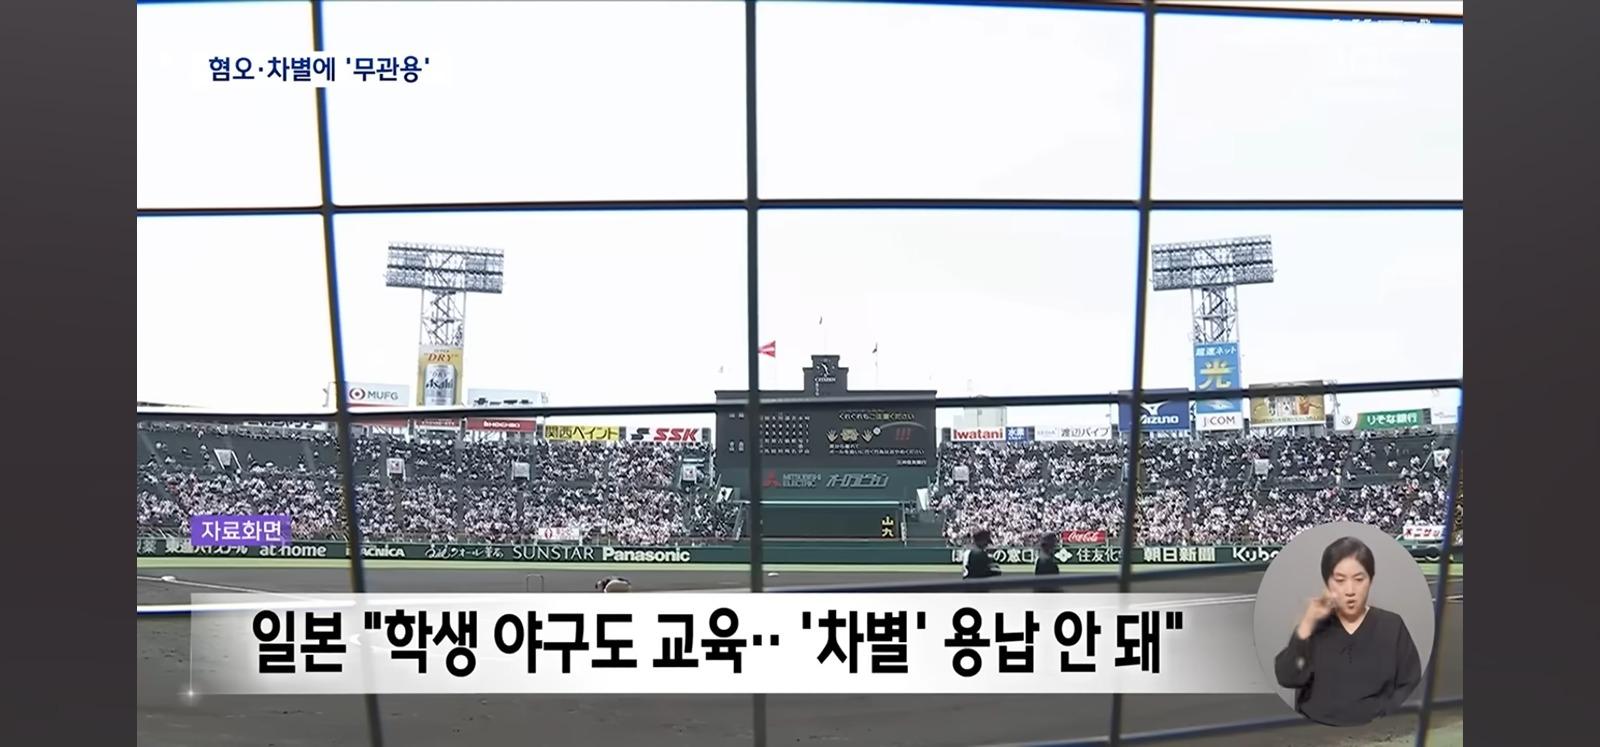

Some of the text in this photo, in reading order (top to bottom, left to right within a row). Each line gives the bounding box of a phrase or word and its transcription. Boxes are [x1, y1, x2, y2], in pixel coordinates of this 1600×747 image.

[1198, 360, 1235, 389] 光
[366, 390, 399, 401] MUFG
[1366, 412, 1418, 426] りそな銀行
[544, 426, 619, 440] 関西ペイント
[653, 428, 700, 441] SSK
[953, 428, 1004, 440] Iwatani
[259, 543, 327, 557] at home
[512, 545, 595, 560] SUNSTAR
[602, 547, 691, 562] Panasonic
[1076, 547, 1124, 562] 住友化
[1143, 547, 1217, 563] 朝日新聞
